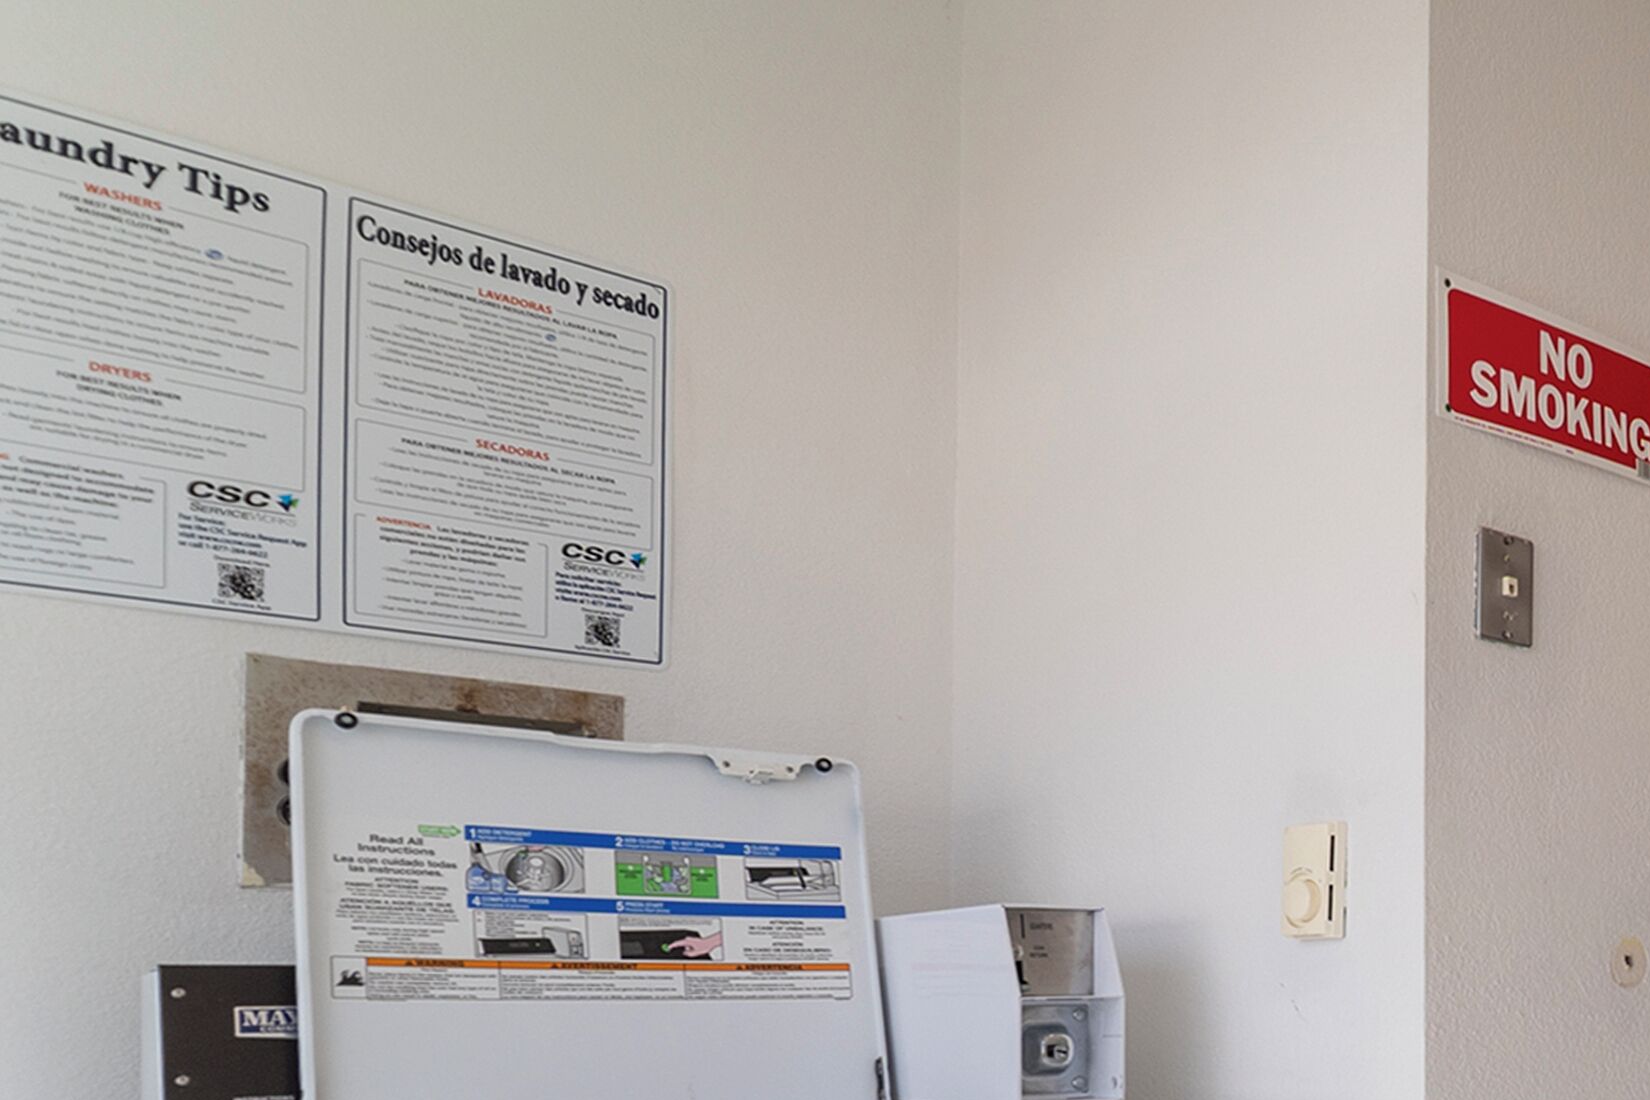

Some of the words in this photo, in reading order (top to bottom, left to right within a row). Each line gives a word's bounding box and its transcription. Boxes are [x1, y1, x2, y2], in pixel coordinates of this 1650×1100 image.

[83, 182, 162, 211] WASHERS
[178, 162, 270, 213] Tips
[356, 214, 463, 266] Consejos
[469, 246, 495, 275] de
[501, 253, 570, 296] lavado
[576, 281, 589, 306] y
[592, 285, 660, 320] secado
[478, 288, 553, 315] LAVADORAS
[1539, 329, 1594, 390] NO
[88, 361, 152, 382] DRYERS
[401, 437, 424, 449] PARA
[425, 441, 462, 455] OBTENER
[501, 456, 549, 472] RESULTADOS
[475, 438, 550, 462] SECADORAS
[187, 481, 271, 507] CSC
[561, 543, 626, 565] CSC
[369, 834, 404, 845] Read
[407, 836, 423, 846] All
[469, 828, 476, 839] 1
[615, 836, 624, 847] 2
[358, 843, 435, 856] Instructions
[743, 844, 751, 855] 3
[333, 854, 354, 863] Lea
[357, 856, 379, 864] con
[381, 857, 424, 868] cuidado
[427, 859, 458, 869] todas
[348, 864, 365, 873] las
[472, 895, 480, 906] 4
[616, 901, 624, 911] 5
